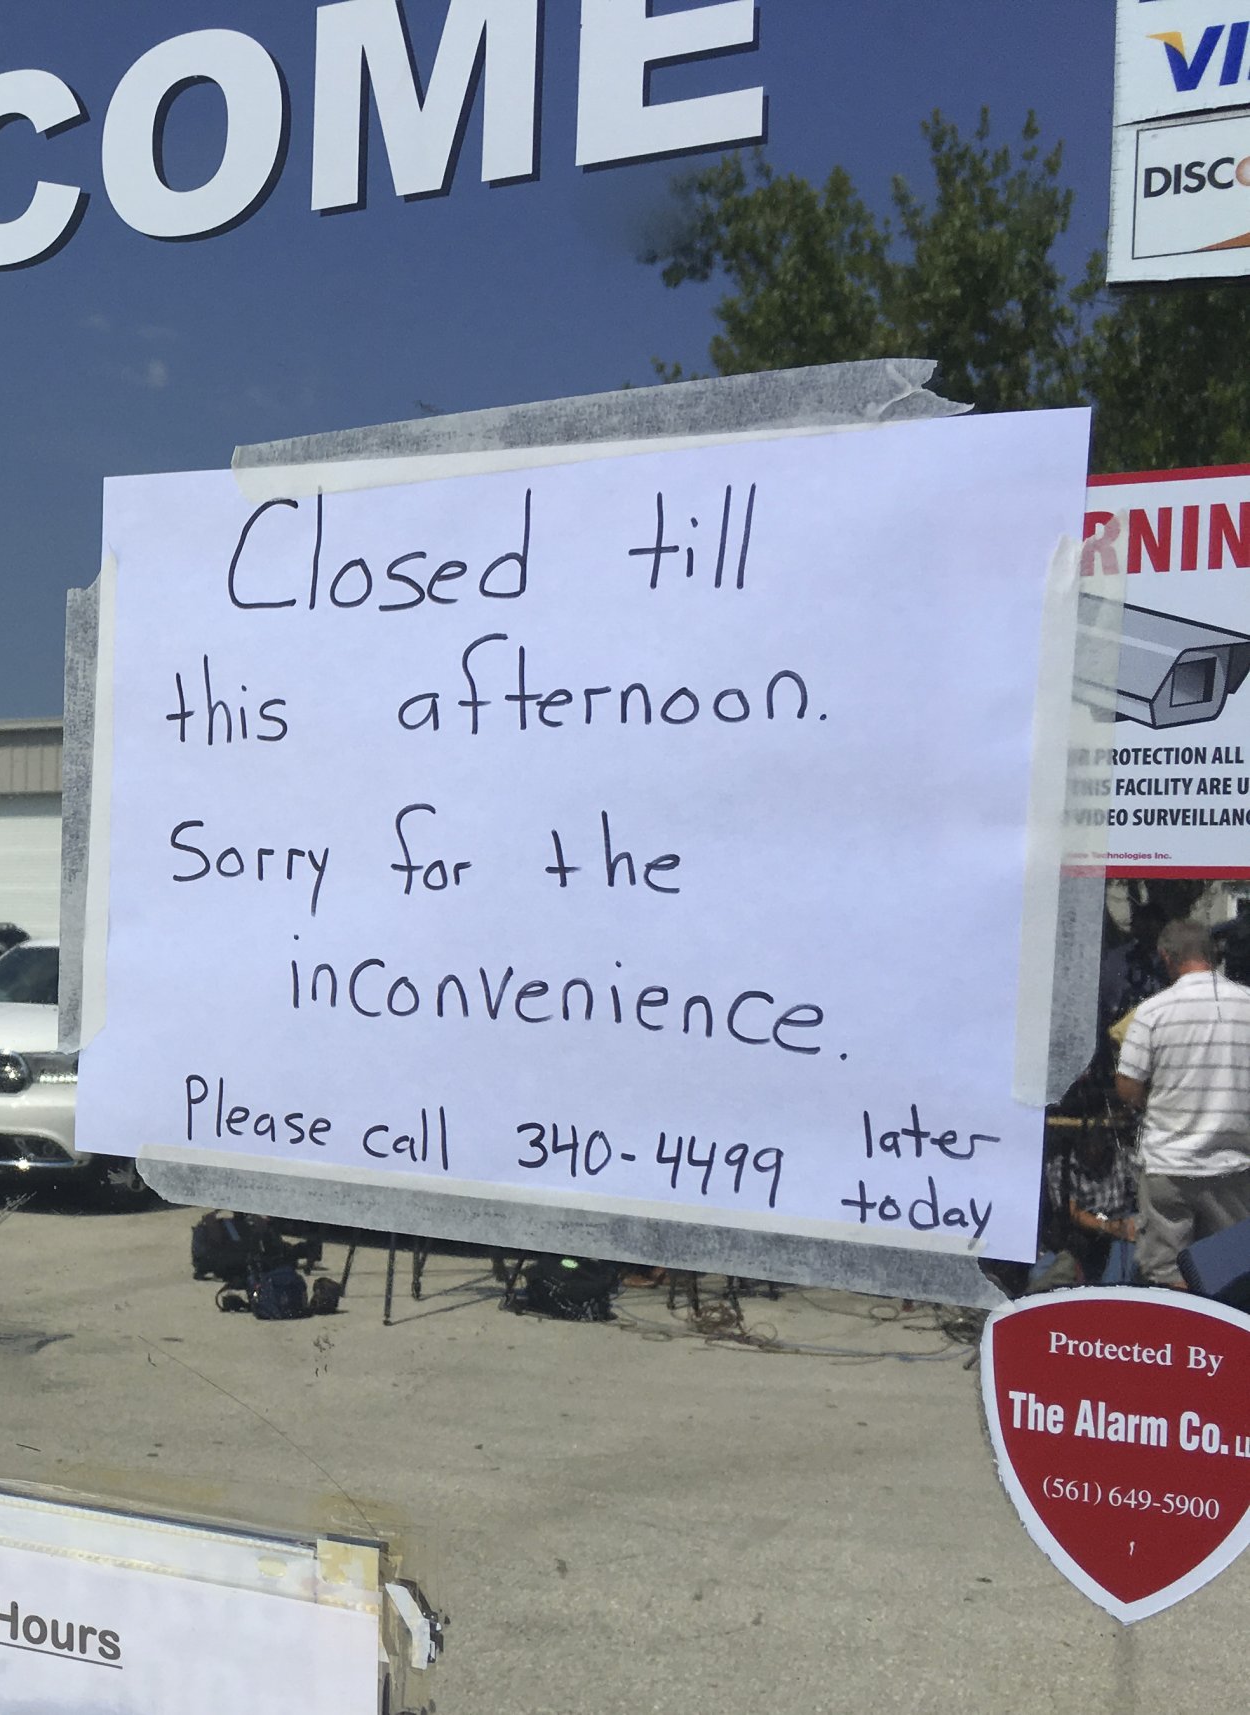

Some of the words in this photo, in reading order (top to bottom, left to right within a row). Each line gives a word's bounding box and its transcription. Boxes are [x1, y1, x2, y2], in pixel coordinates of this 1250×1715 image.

[1146, 21, 1250, 92] VI
[228, 486, 532, 610] Closed
[629, 484, 756, 590] till
[165, 655, 290, 748] this
[397, 634, 828, 732] afternoon.
[1095, 747, 1207, 766] PROTECTION
[1211, 746, 1244, 764] ALL
[1115, 777, 1193, 796] FACILITY
[1196, 777, 1232, 795] ARE
[1075, 808, 1128, 826] VIDEO
[171, 821, 330, 917] Sorry
[390, 804, 472, 895] for
[545, 811, 681, 894] the
[1154, 852, 1172, 860] Inc.
[185, 1074, 331, 1148] Please
[362, 1106, 449, 1170] call
[517, 1122, 785, 1208] 340-4499
[862, 1104, 1000, 1160] later
[841, 1175, 993, 1250] today
[1049, 1331, 1172, 1366] Protected
[1187, 1345, 1224, 1377] By
[1009, 1391, 1064, 1434] The
[1074, 1400, 1168, 1447] Alarm
[1179, 1411, 1229, 1454] Co.
[1042, 1475, 1102, 1505] (561)
[1108, 1487, 1220, 1520] 649-5900
